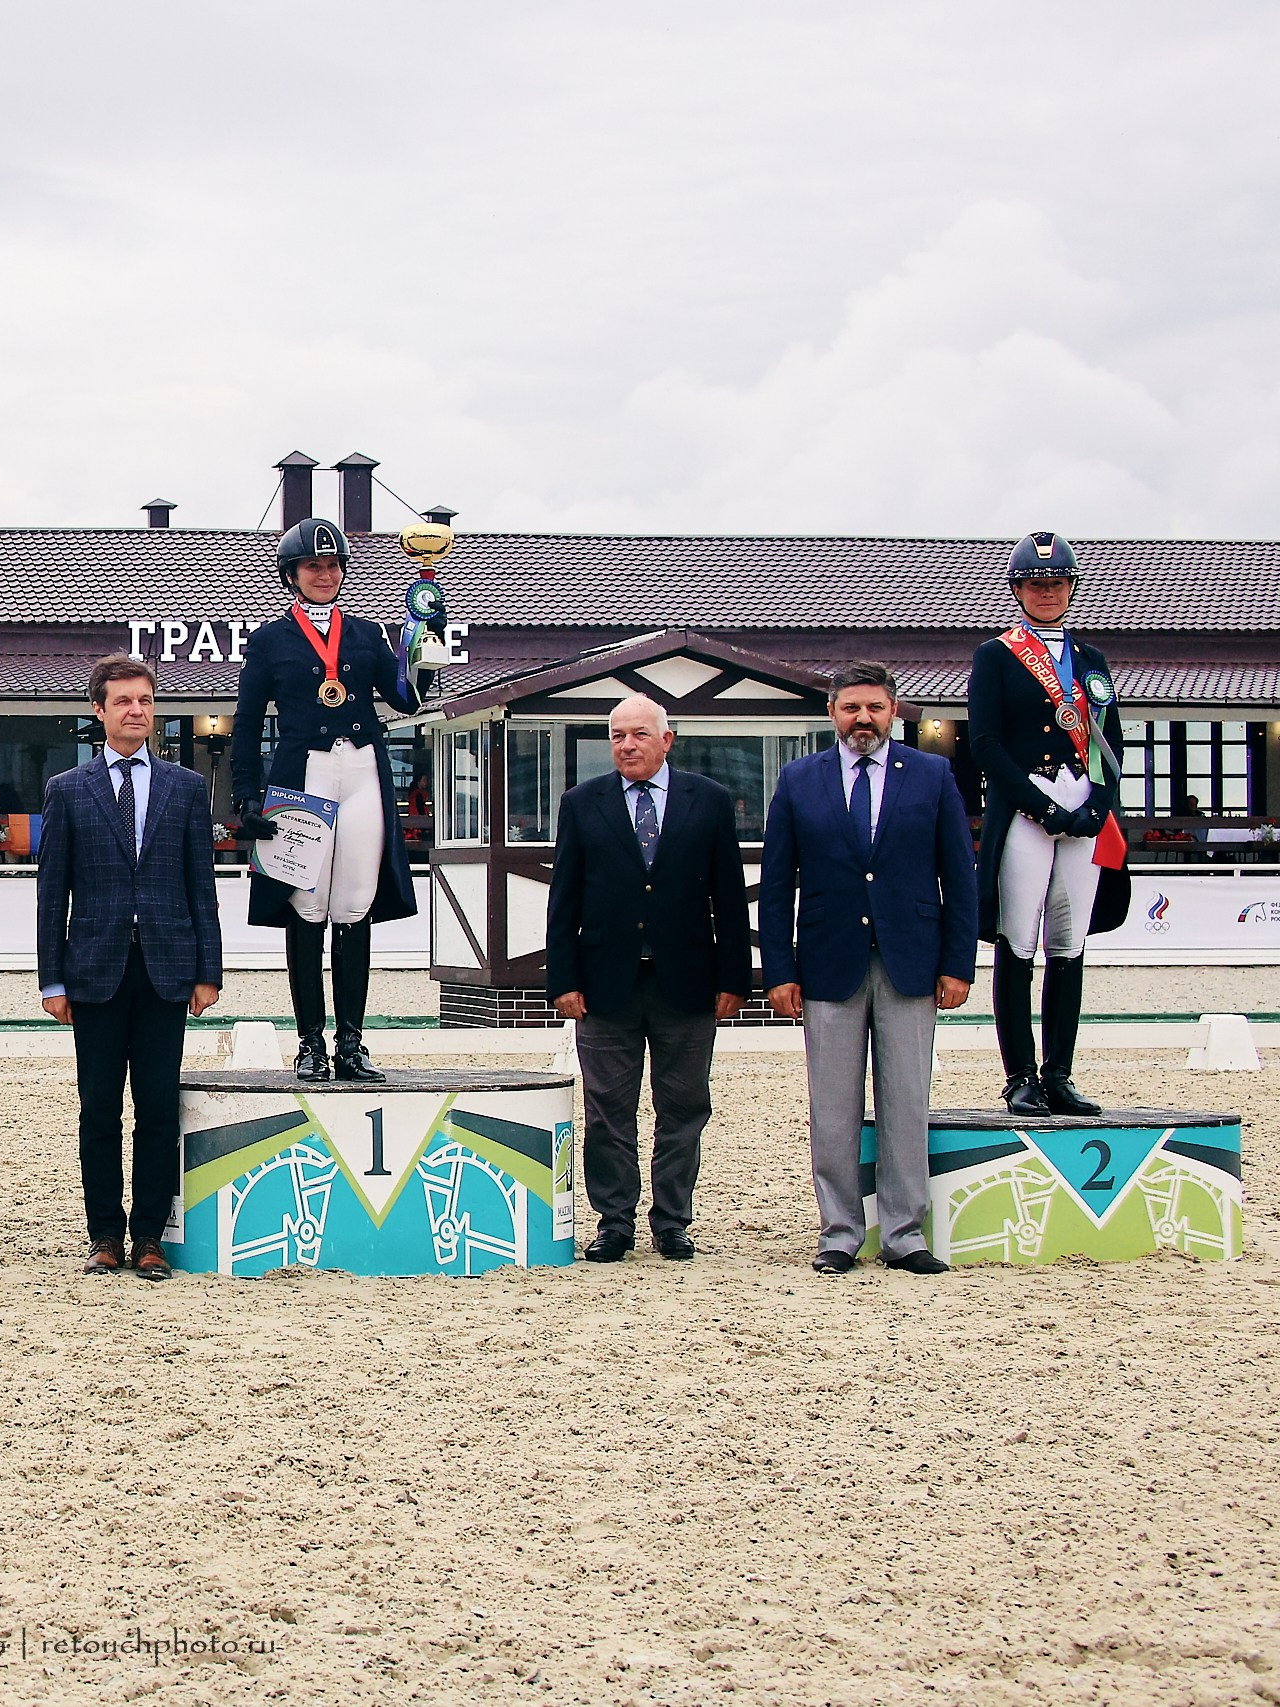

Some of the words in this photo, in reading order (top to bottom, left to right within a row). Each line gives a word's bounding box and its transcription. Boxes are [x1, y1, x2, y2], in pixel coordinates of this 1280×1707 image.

[271, 790, 306, 803] DIPLOMA
[362, 1106, 393, 1176] 1
[1079, 1139, 1116, 1191] 2
